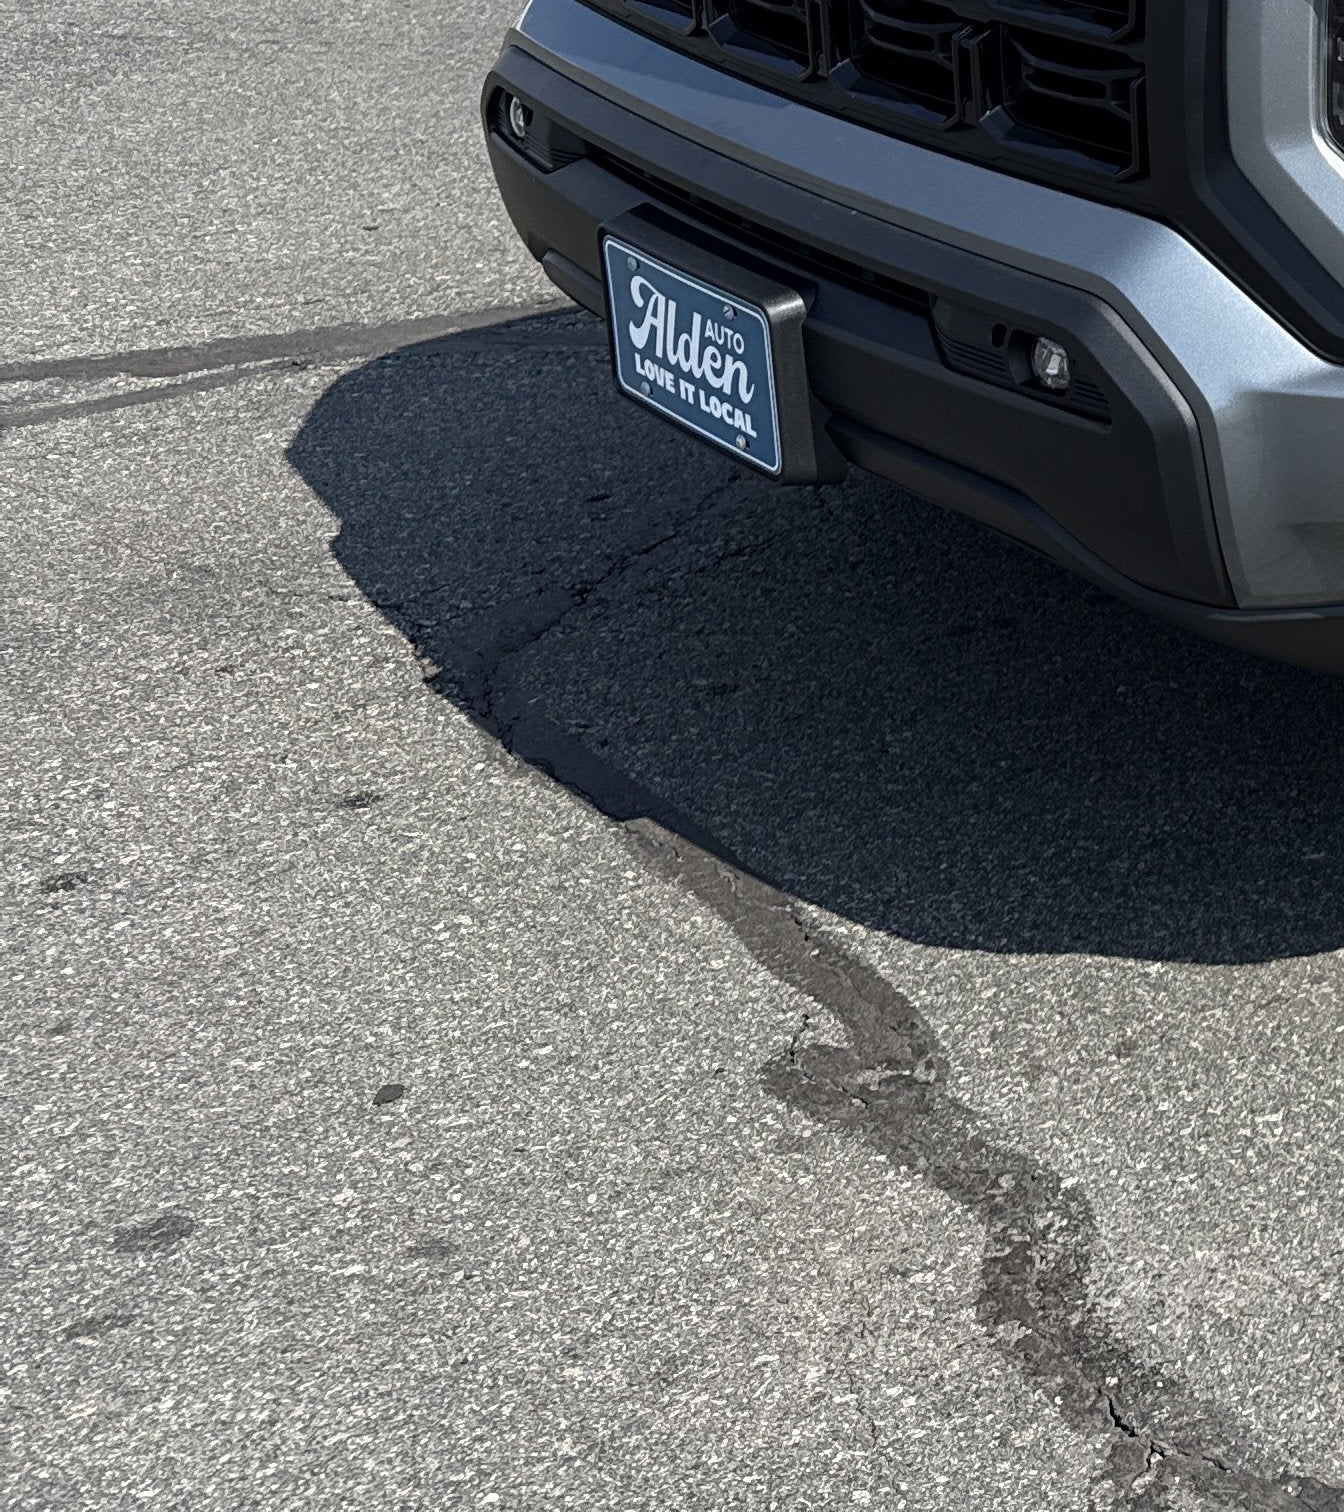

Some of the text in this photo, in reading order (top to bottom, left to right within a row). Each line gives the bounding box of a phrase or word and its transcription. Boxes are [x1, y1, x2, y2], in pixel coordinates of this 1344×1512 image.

[629, 275, 755, 404] Alden
[704, 318, 745, 354] AUTO
[634, 352, 757, 438] LOVE IT LOCAL
